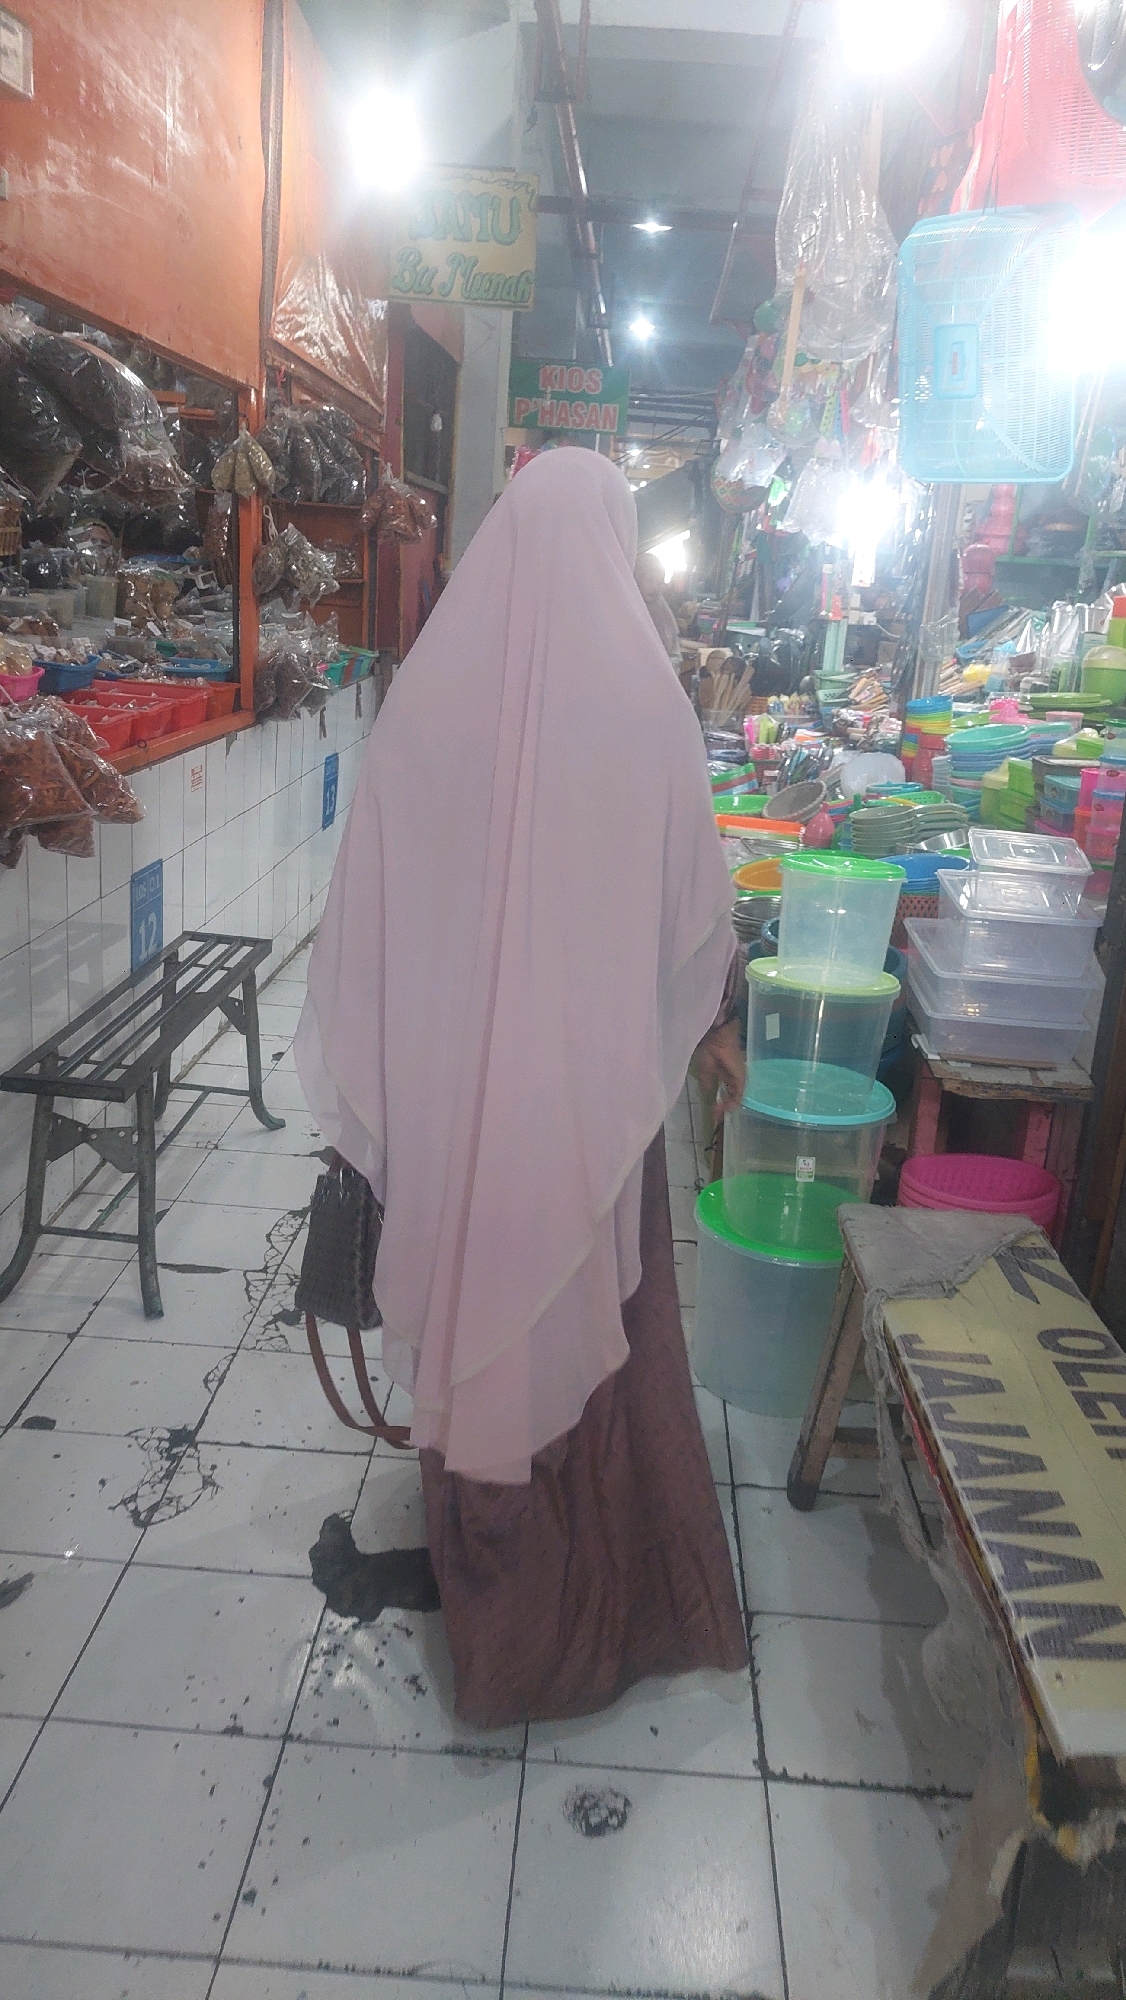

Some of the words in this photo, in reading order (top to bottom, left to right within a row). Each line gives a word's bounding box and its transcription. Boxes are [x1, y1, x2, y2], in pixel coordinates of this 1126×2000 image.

[408, 189, 522, 246] JAMU
[392, 248, 438, 294] Bu
[539, 365, 603, 395] KIOS
[514, 397, 619, 432] P'HASAN
[138, 912, 158, 961] 12
[899, 1334, 1126, 1659] JAJANAN
